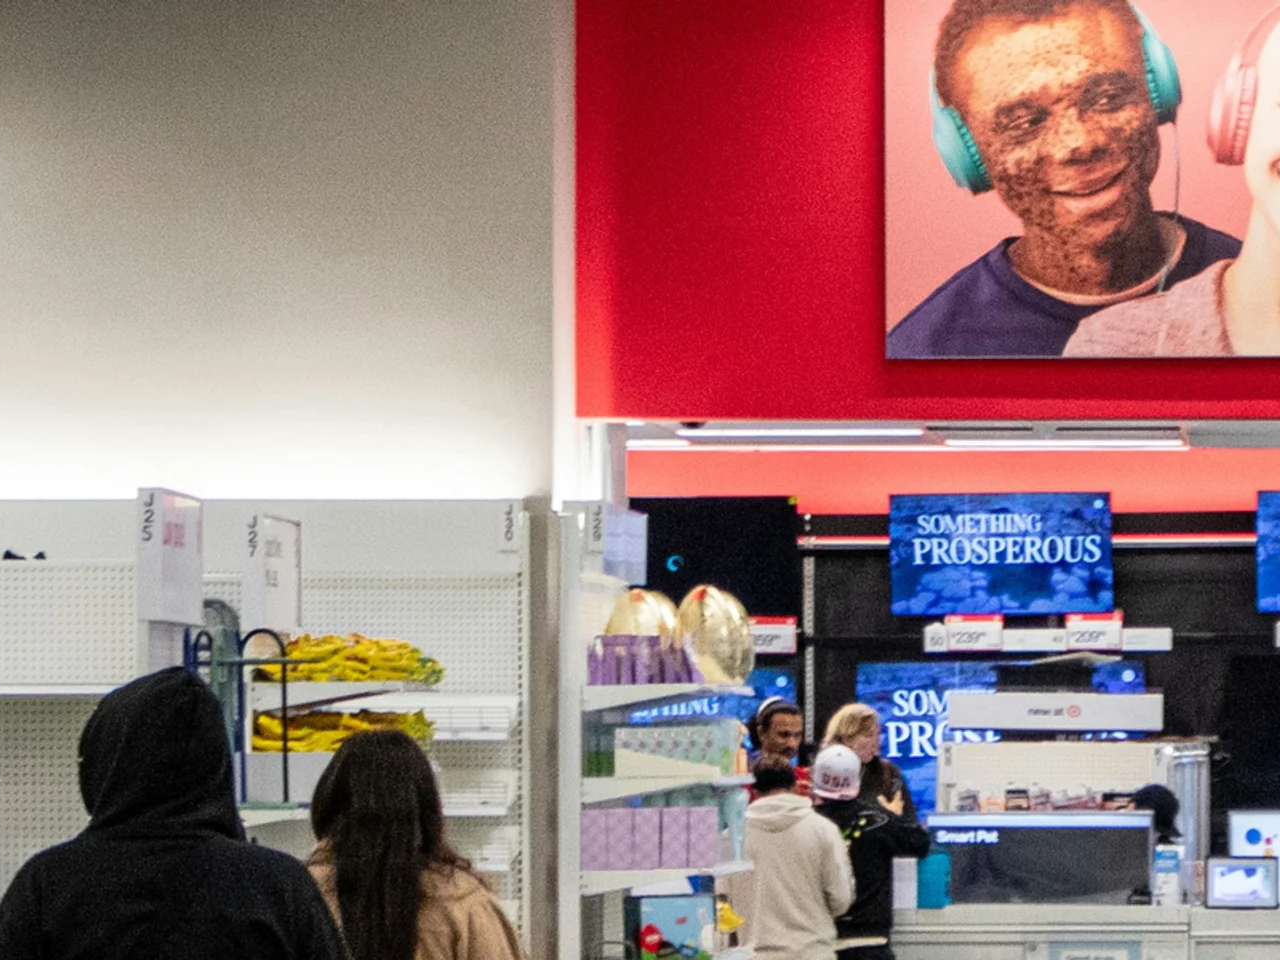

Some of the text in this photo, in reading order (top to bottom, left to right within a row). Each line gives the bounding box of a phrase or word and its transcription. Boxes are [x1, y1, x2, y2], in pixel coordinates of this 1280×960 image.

[917, 513, 1042, 535] SOMETHING
[912, 535, 1102, 565] PROSPEROUS
[936, 829, 975, 844] Smart
